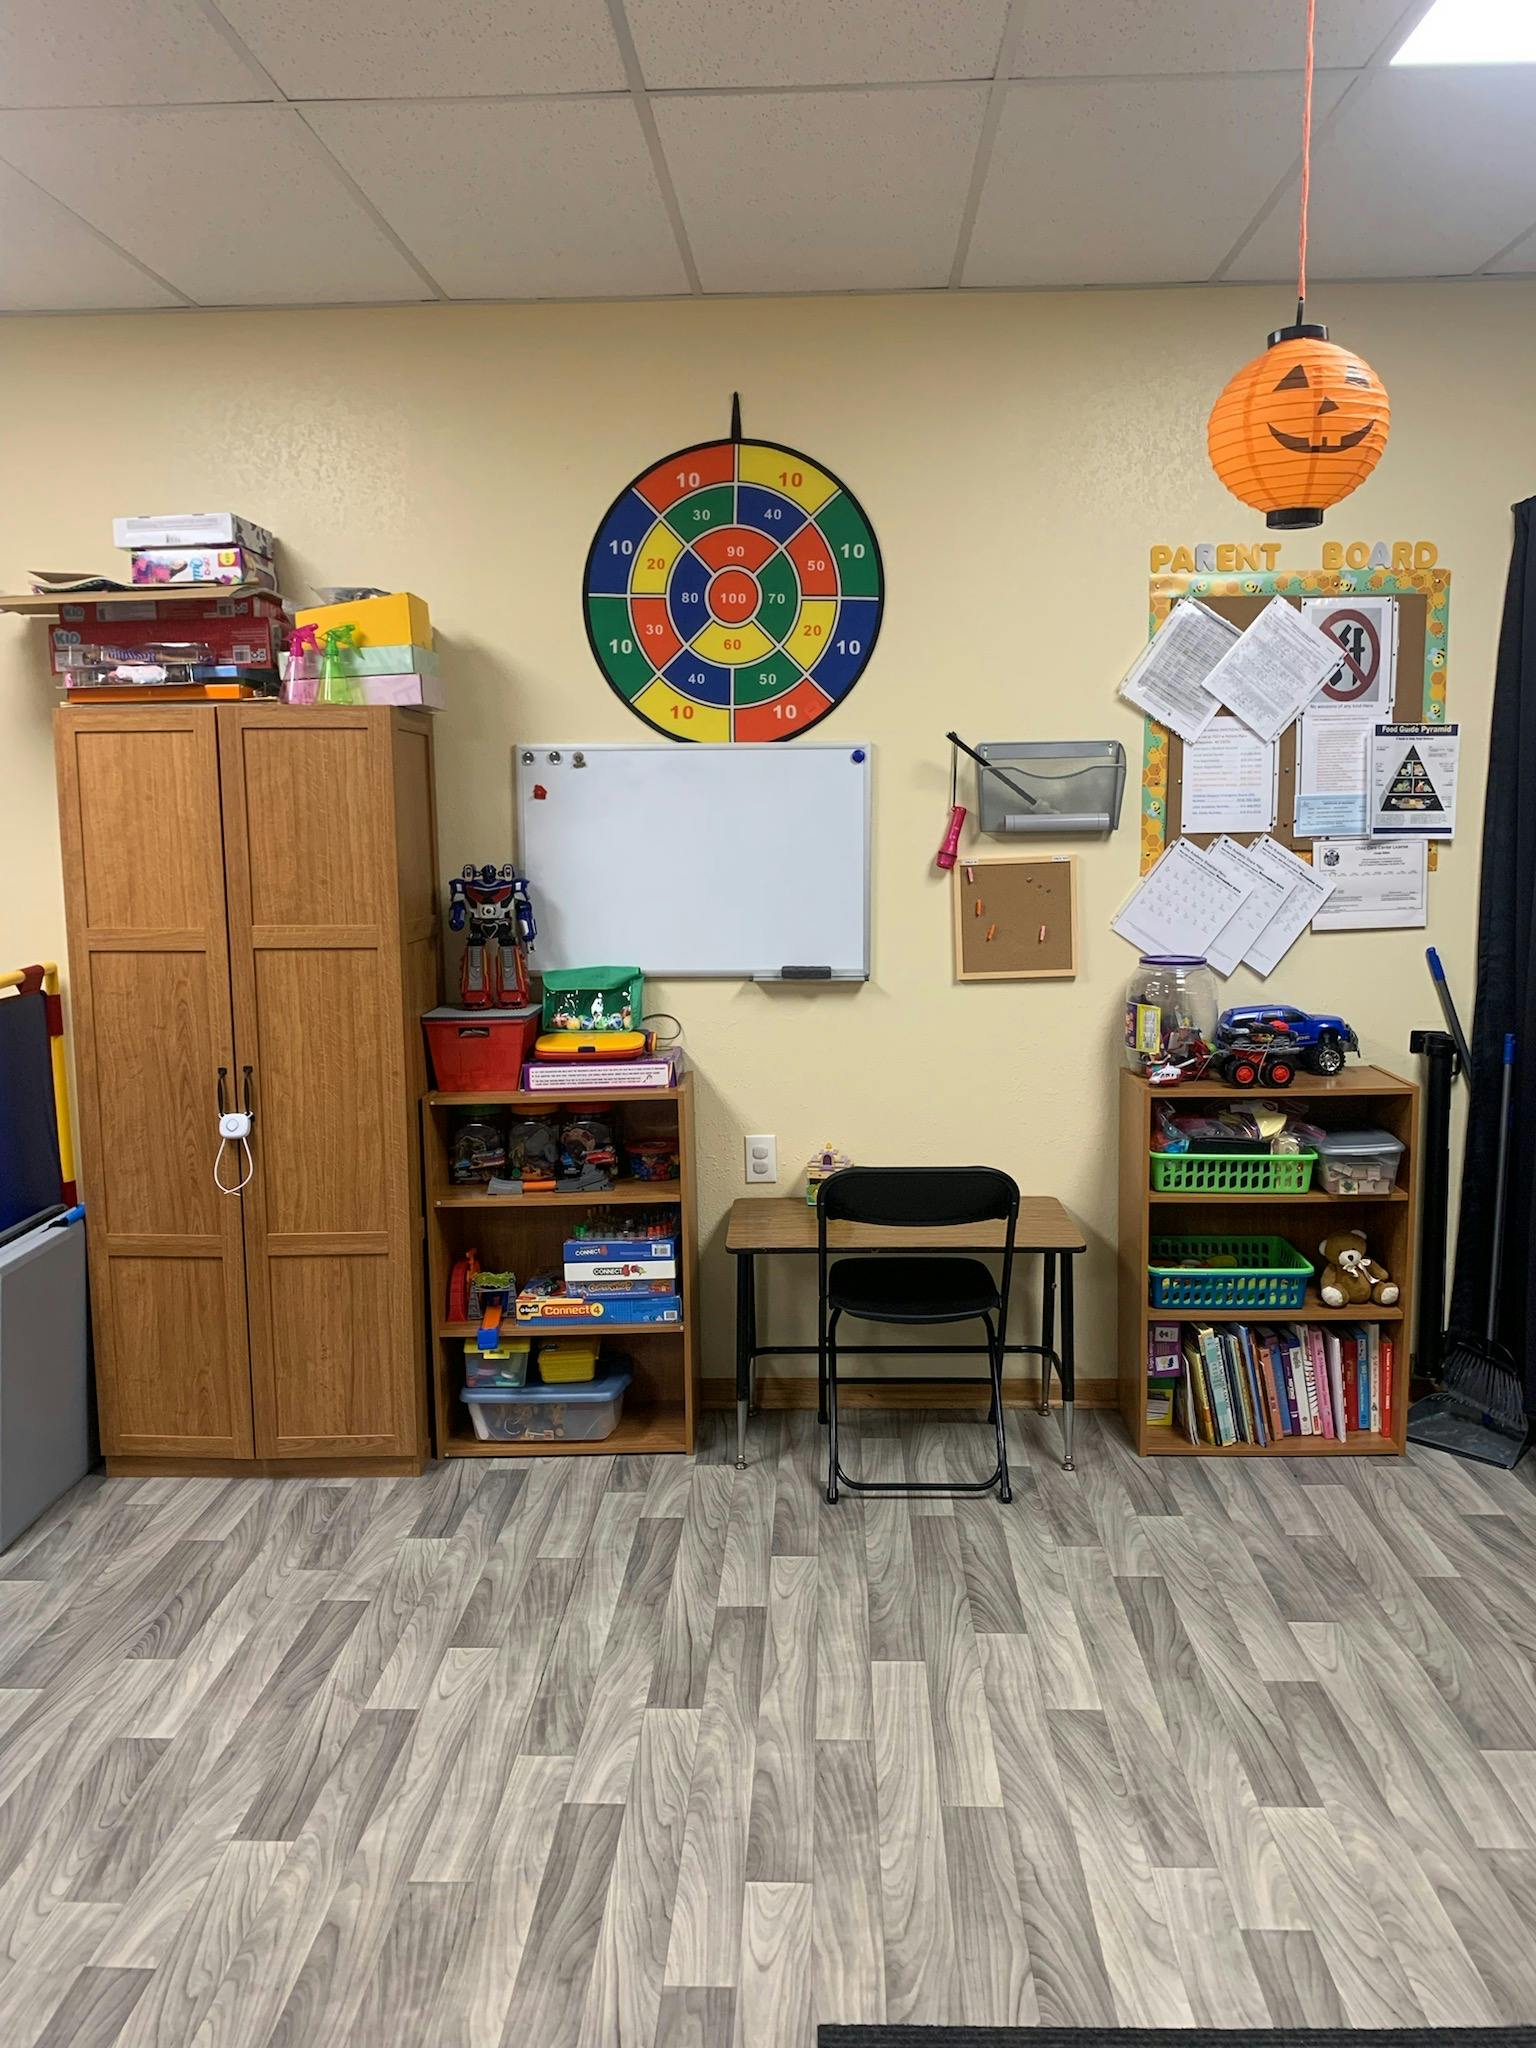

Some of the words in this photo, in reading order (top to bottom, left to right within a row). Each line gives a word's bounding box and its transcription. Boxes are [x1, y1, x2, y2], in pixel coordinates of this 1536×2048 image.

[676, 473, 701, 487] 10
[779, 472, 802, 487] 10
[693, 509, 711, 521] 30
[764, 509, 782, 521] 40
[609, 540, 633, 555] 10
[726, 546, 745, 557] 90
[841, 544, 865, 558] 10
[1150, 543, 1281, 573] PARENT
[1322, 541, 1438, 570] BOARD
[647, 558, 666, 571] 20
[807, 560, 825, 572] 50
[681, 592, 699, 604] 80
[720, 593, 746, 604] 100
[768, 593, 786, 604] 70
[646, 624, 664, 636] 30
[803, 624, 822, 637] 20
[609, 640, 632, 654] 10
[723, 639, 742, 650] 60
[837, 640, 861, 655] 10
[688, 673, 705, 685] 40
[759, 673, 777, 685] 50
[670, 705, 694, 719] 10
[773, 705, 797, 719] 10
[1421, 725, 1451, 734] Pyramid
[575, 1248, 600, 1256] CONNECT
[544, 1307, 590, 1315] Connect
[593, 1306, 600, 1314] 4
